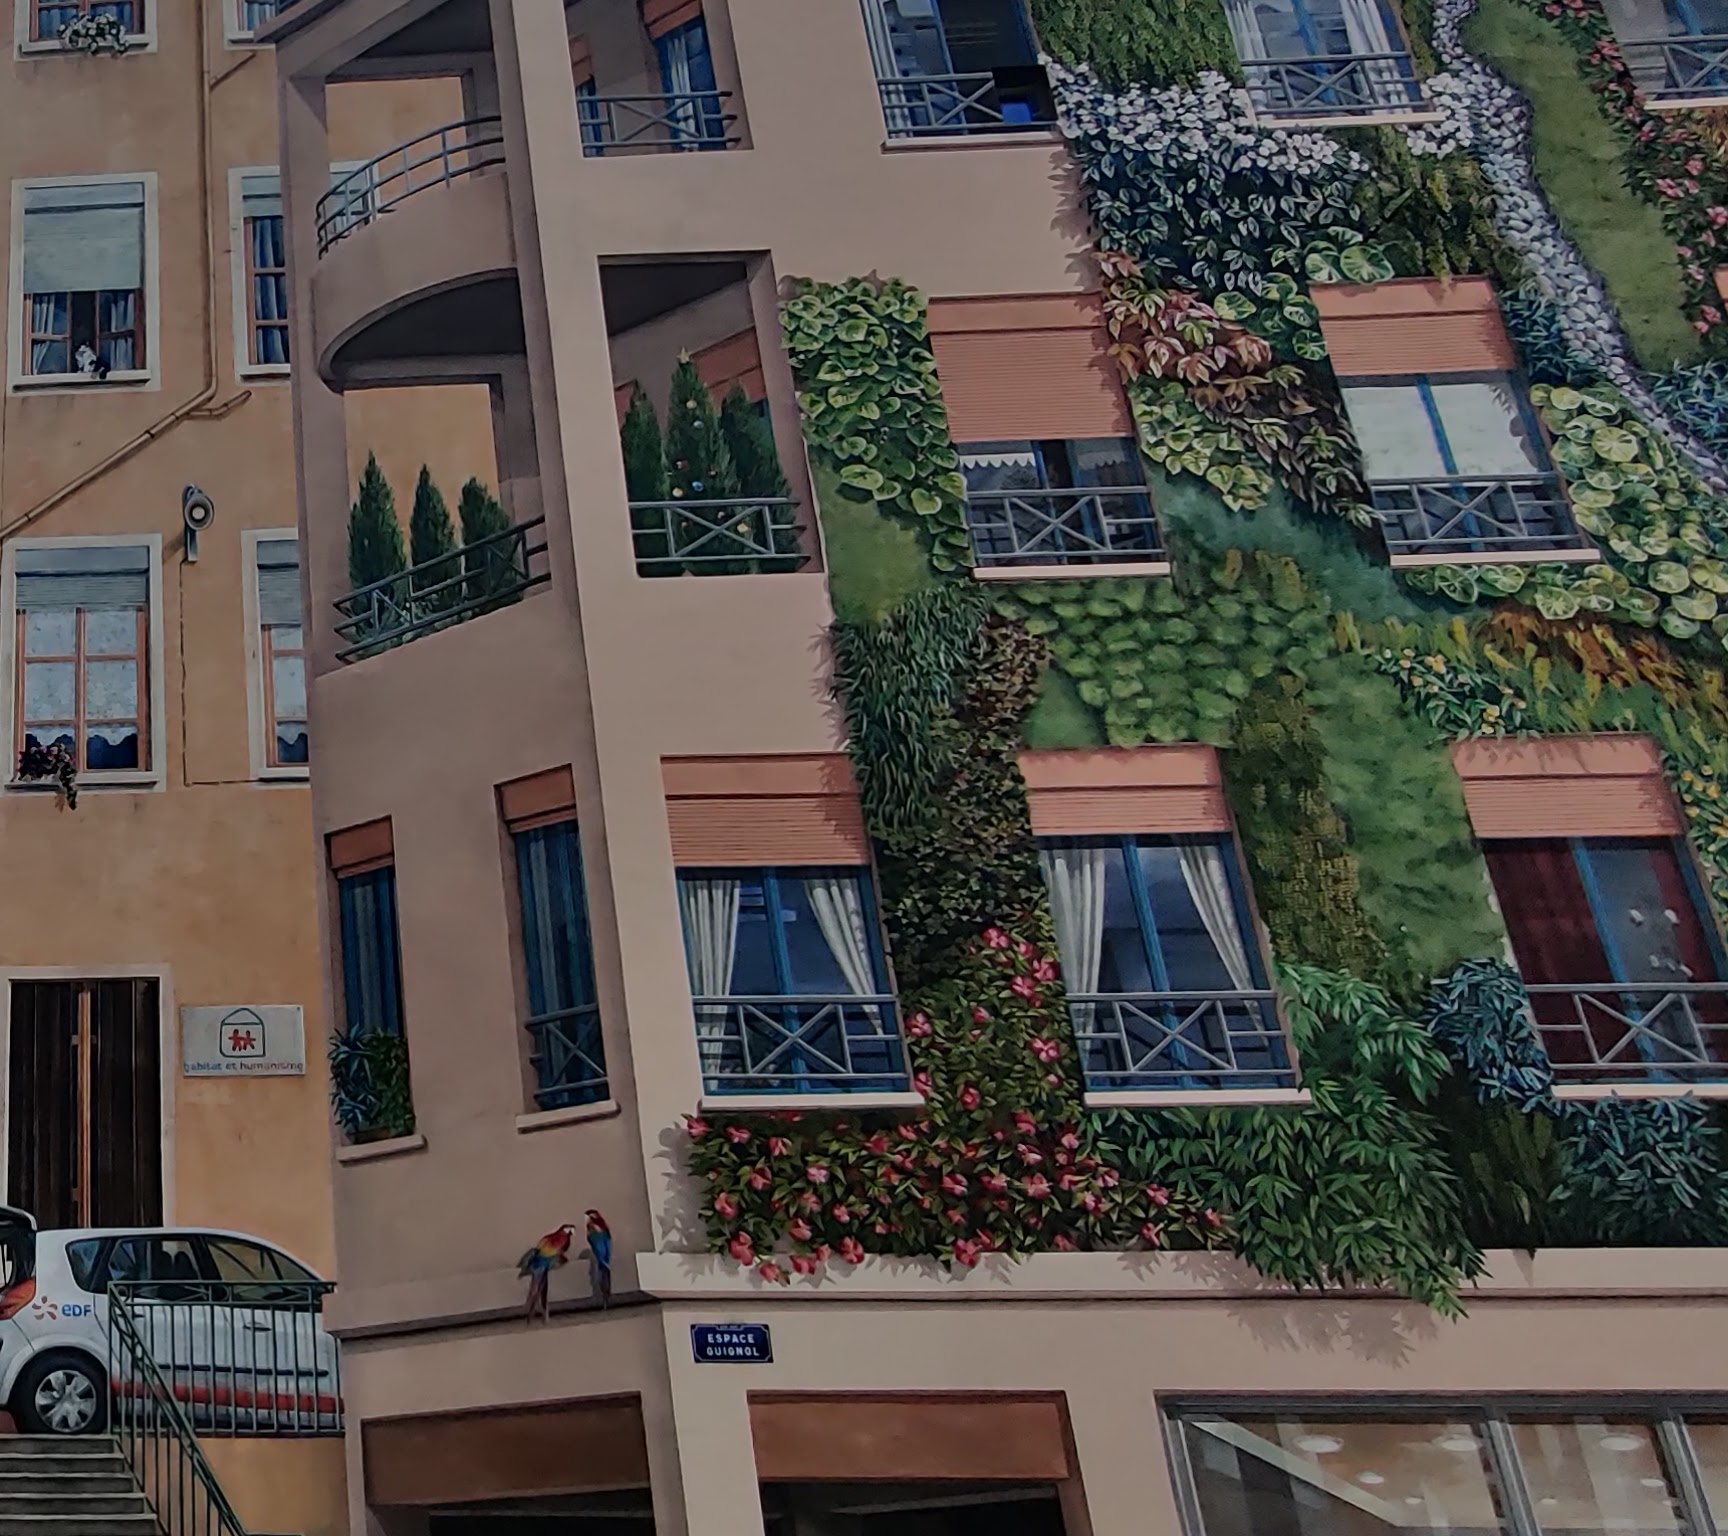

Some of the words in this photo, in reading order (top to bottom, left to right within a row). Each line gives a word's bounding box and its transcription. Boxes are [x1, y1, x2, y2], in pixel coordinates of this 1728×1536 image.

[226, 1062, 237, 1071] et
[707, 1333, 755, 1344] ESPACE
[706, 1346, 760, 1357] GUIGNOL
